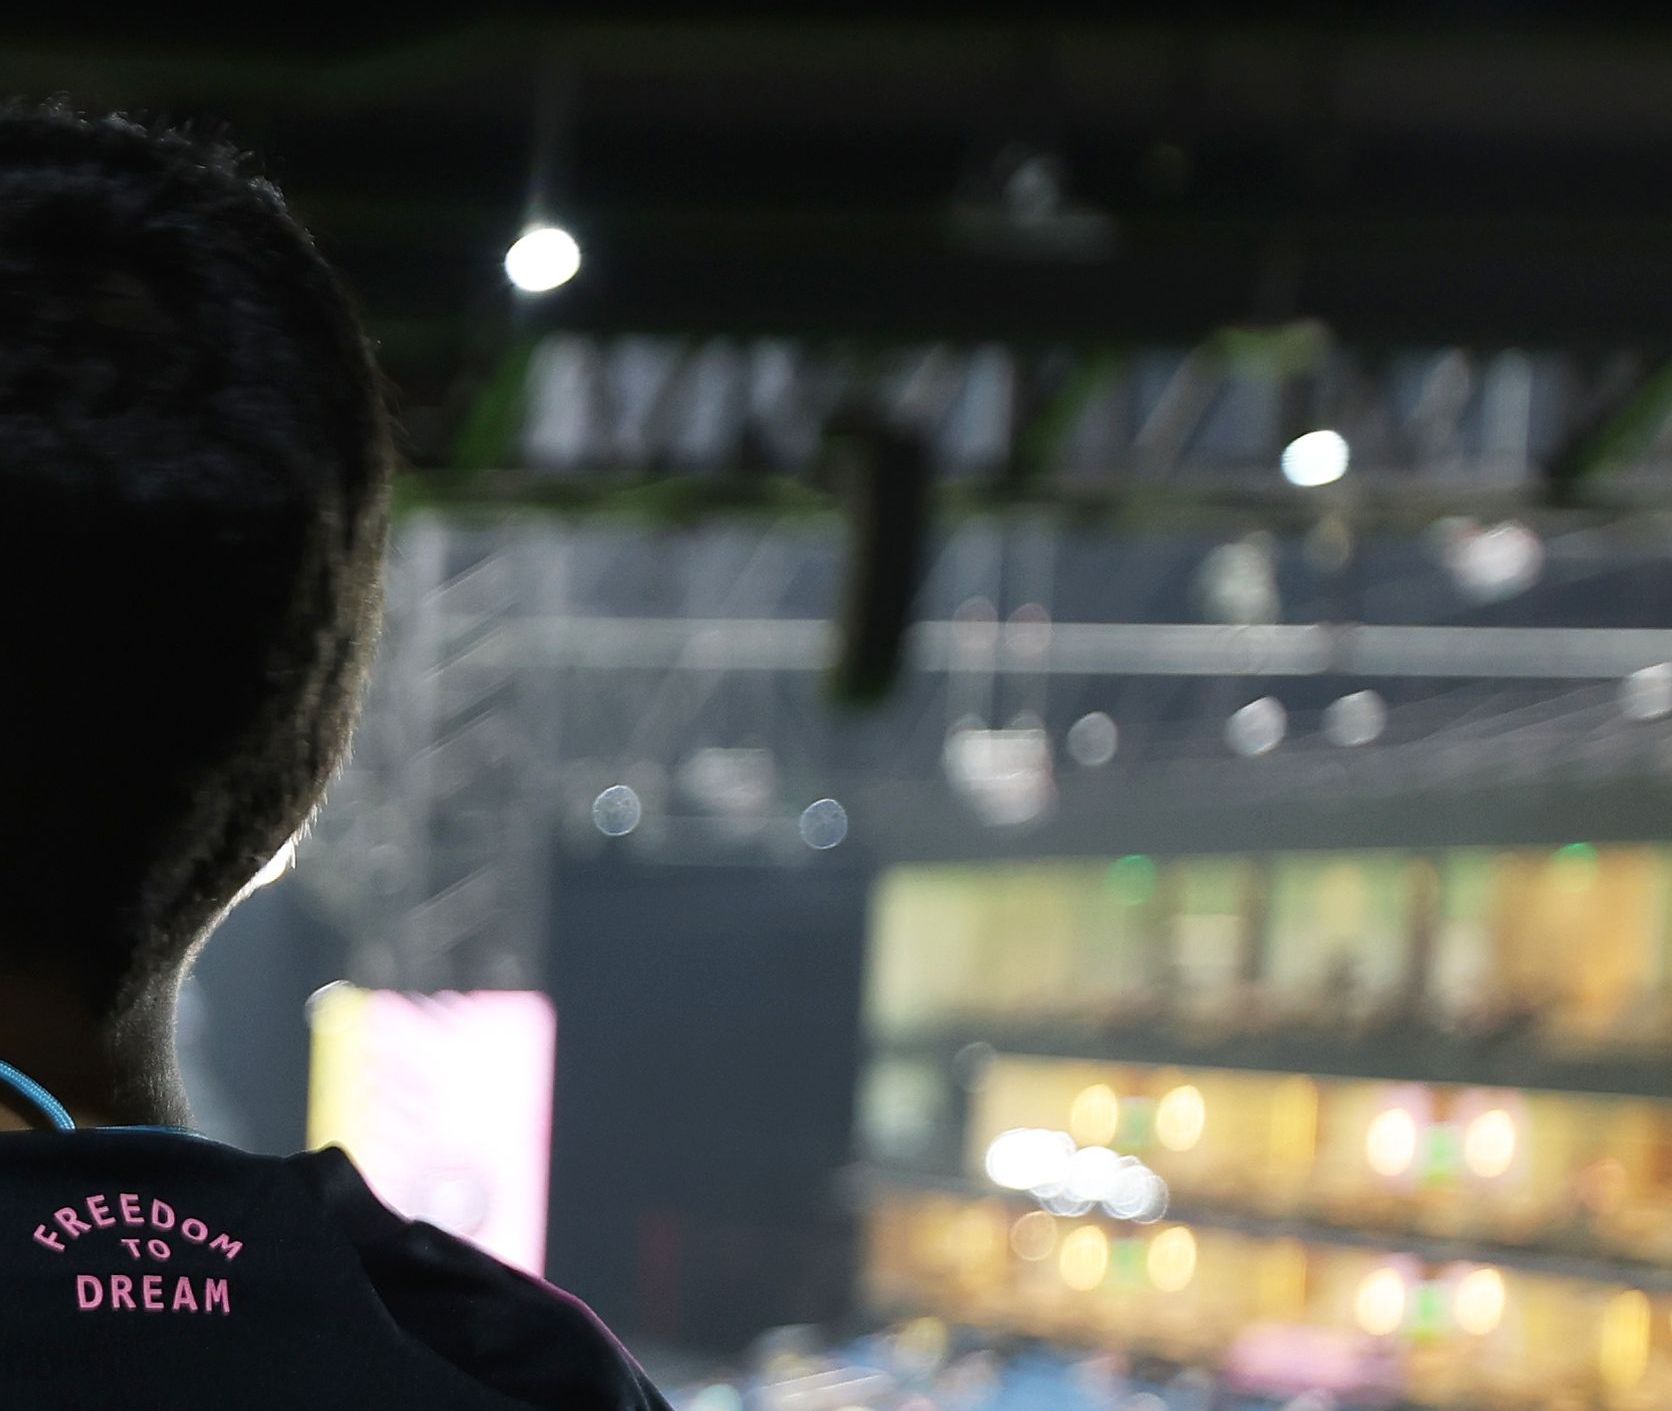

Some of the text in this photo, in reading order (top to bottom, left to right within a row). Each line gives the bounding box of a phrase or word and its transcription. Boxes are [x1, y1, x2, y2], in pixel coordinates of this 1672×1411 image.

[33, 1192, 244, 1261] FREEDOM
[121, 1238, 172, 1261] TO
[76, 1274, 231, 1315] DREAM
